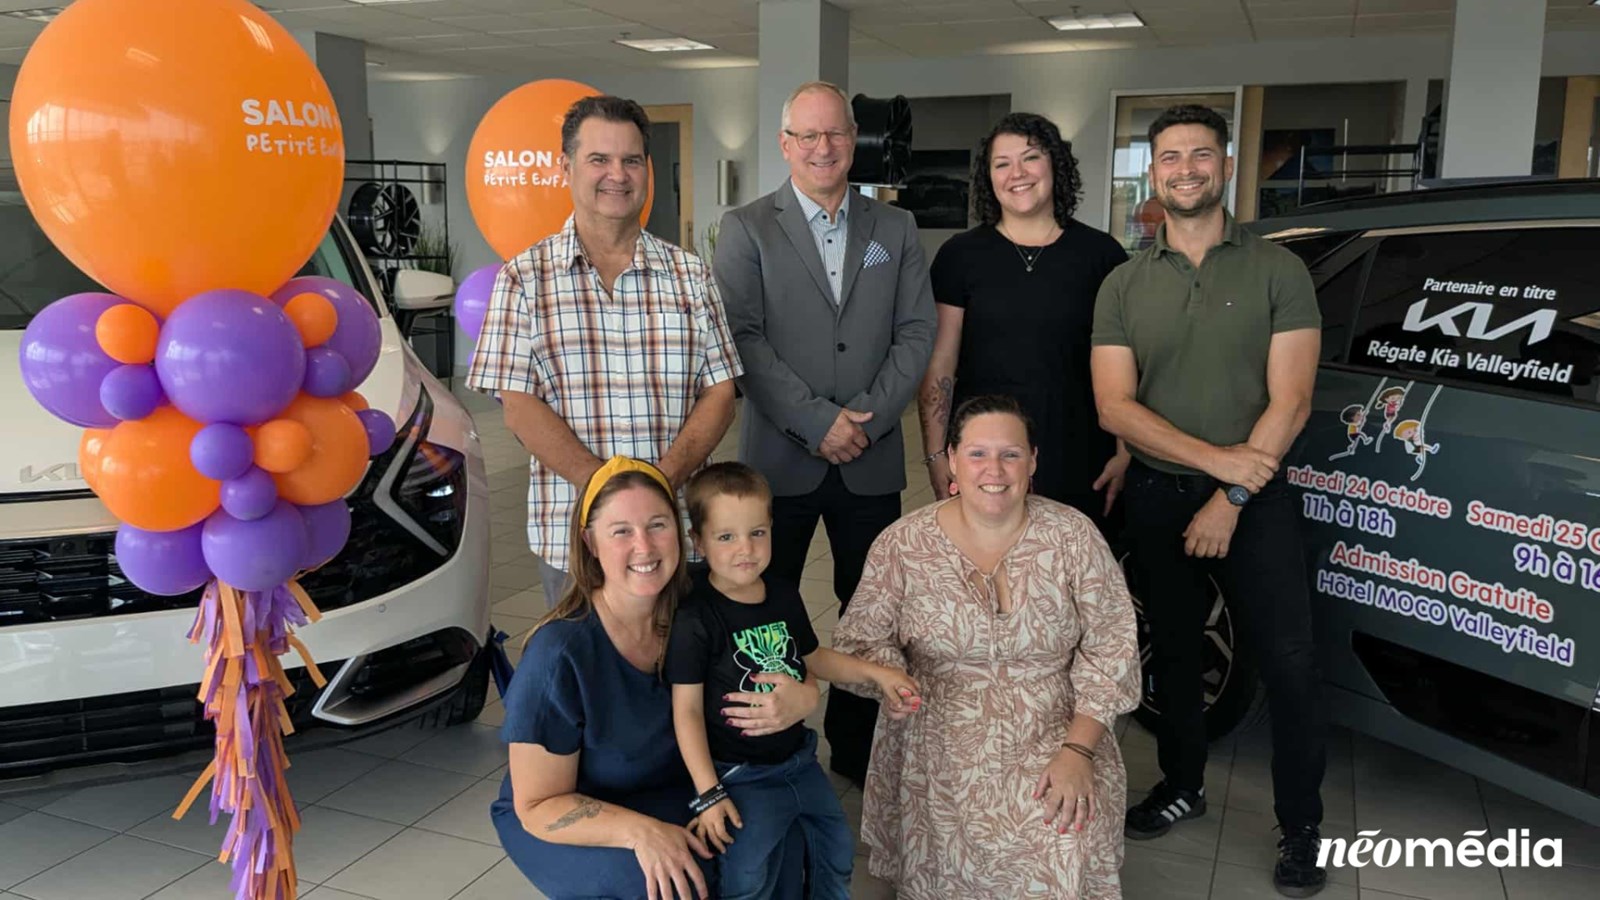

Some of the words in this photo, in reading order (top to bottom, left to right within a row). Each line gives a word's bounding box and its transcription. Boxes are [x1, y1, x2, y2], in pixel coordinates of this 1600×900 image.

[242, 98, 333, 130] SALON
[483, 150, 553, 169] SALON
[1423, 278, 1495, 296] Partenaire
[1499, 285, 1518, 298] en
[1523, 284, 1557, 301] titre
[1402, 297, 1558, 346] KIA
[1366, 340, 1427, 364] Régate
[1430, 347, 1460, 368] Kia
[1466, 352, 1574, 384] Valleyfield
[20, 462, 84, 484] KI
[1287, 464, 1344, 493] ndredi
[1346, 475, 1371, 500] 24
[1371, 483, 1451, 519] Octobre
[1303, 493, 1333, 522] 11h
[1336, 500, 1355, 527] à
[1357, 505, 1396, 538] 18h
[1466, 500, 1554, 541] Samedi
[1553, 520, 1588, 550] 25
[1329, 540, 1446, 593] Admission
[1450, 570, 1554, 623] Gratuite
[1513, 542, 1550, 577] 9h
[1552, 551, 1576, 584] à
[1317, 569, 1374, 606] Hôtel
[1375, 587, 1447, 625] MOCO
[1448, 603, 1575, 667] Valleyfield
